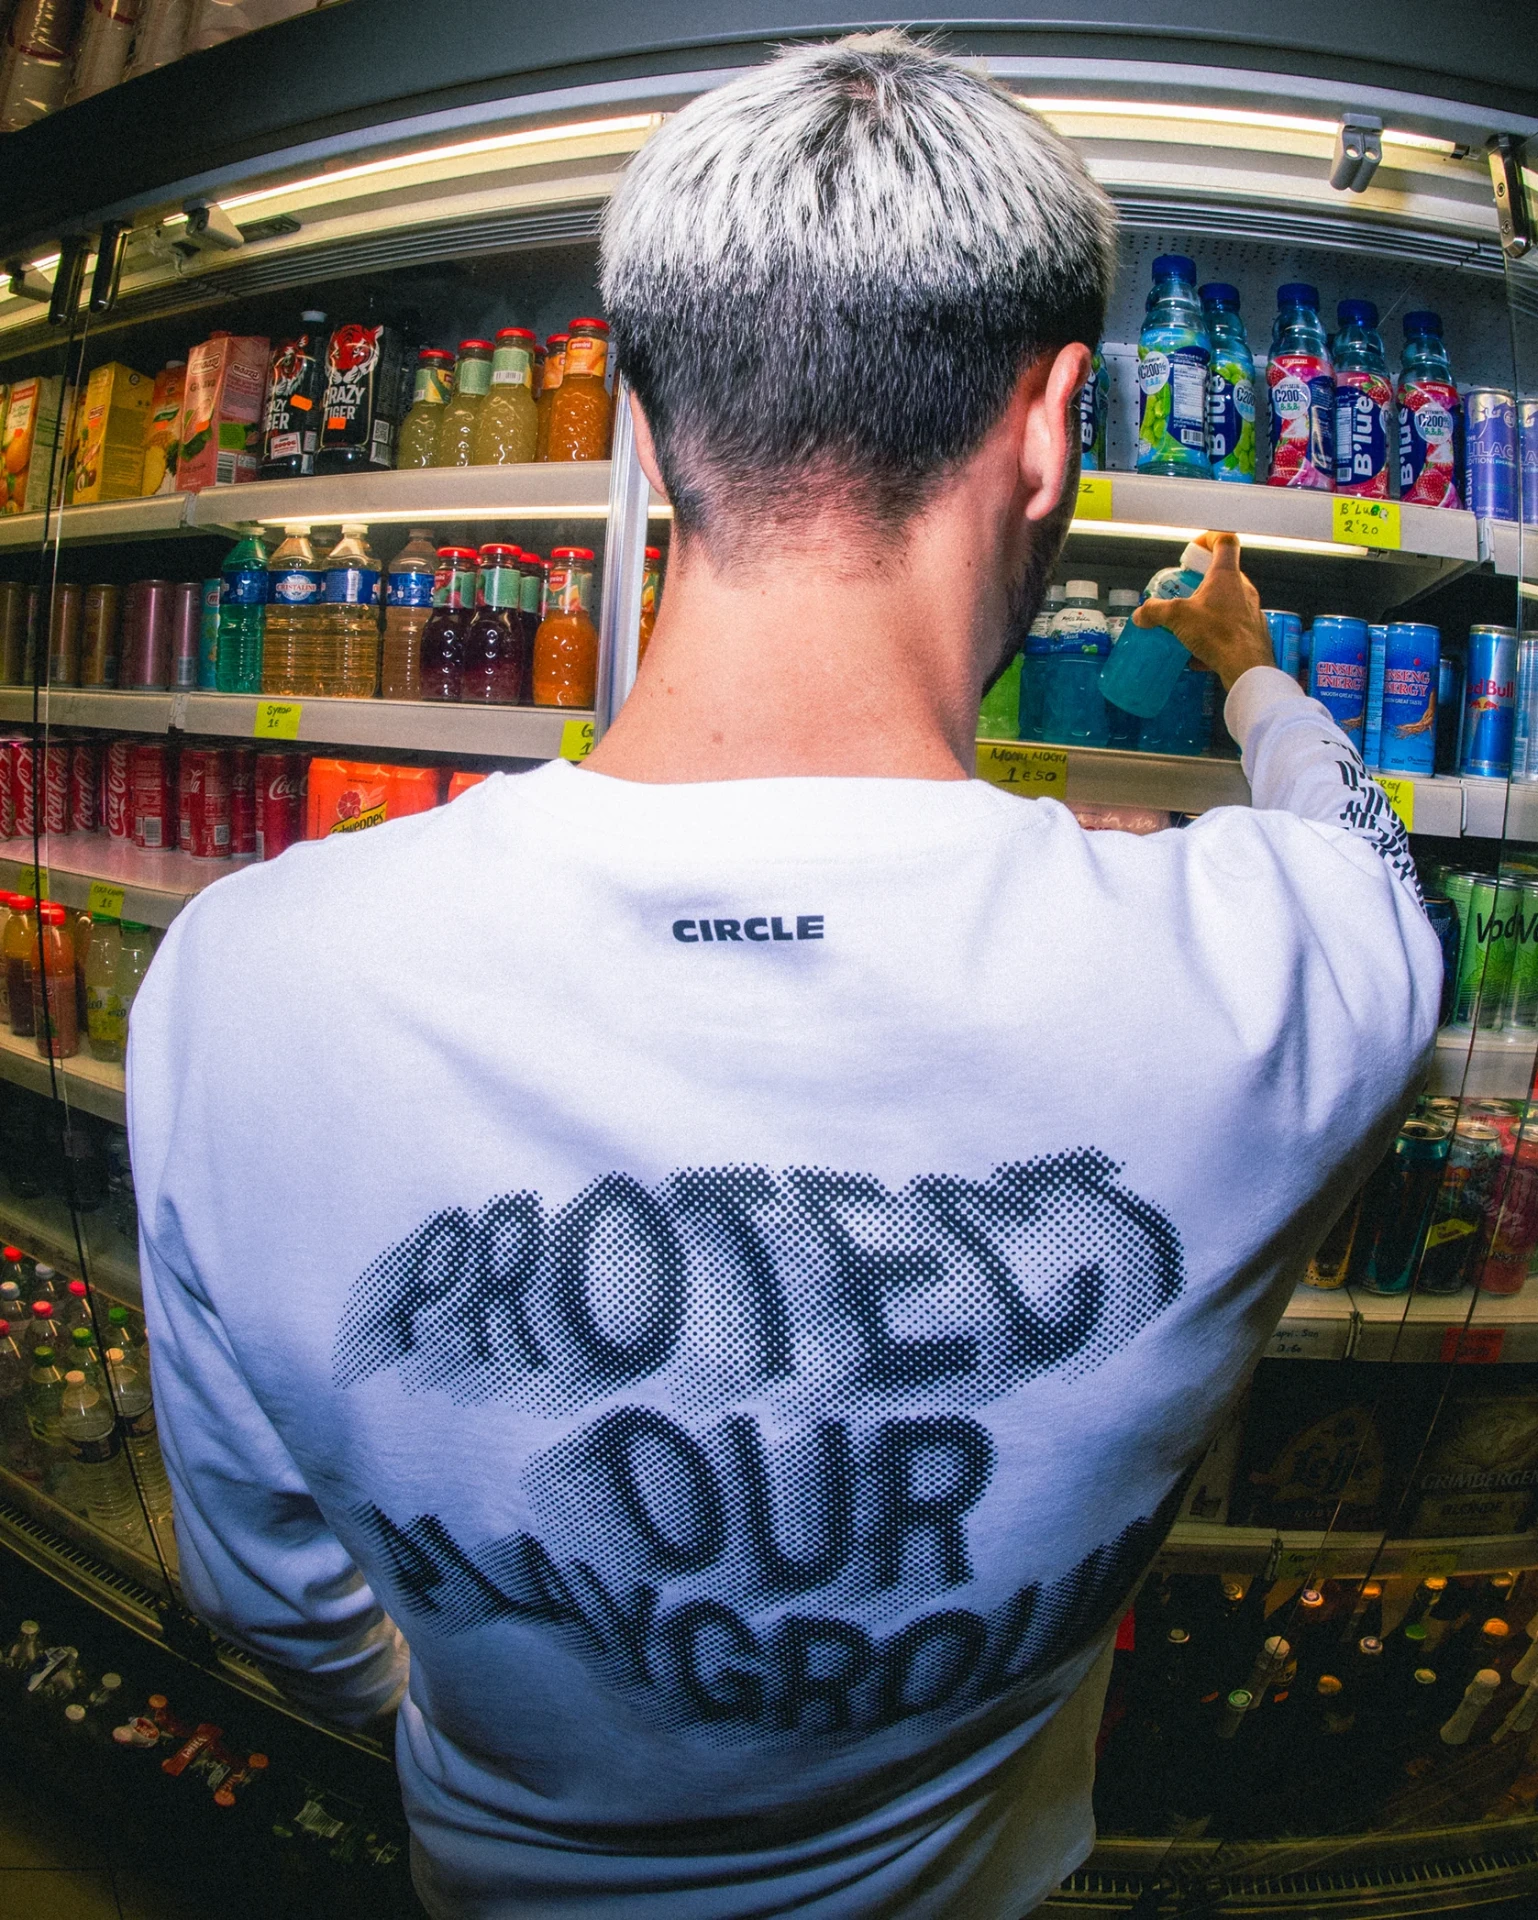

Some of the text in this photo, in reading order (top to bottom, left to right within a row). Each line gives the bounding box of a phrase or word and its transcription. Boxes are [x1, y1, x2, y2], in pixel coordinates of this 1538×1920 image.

[323, 384, 366, 408] CRAZY
[325, 405, 357, 420] TIGER
[1352, 396, 1374, 477] B'lue
[1467, 678, 1514, 698] ed Bull
[672, 914, 825, 943] CIRCLE
[522, 1405, 998, 1600] OUR
